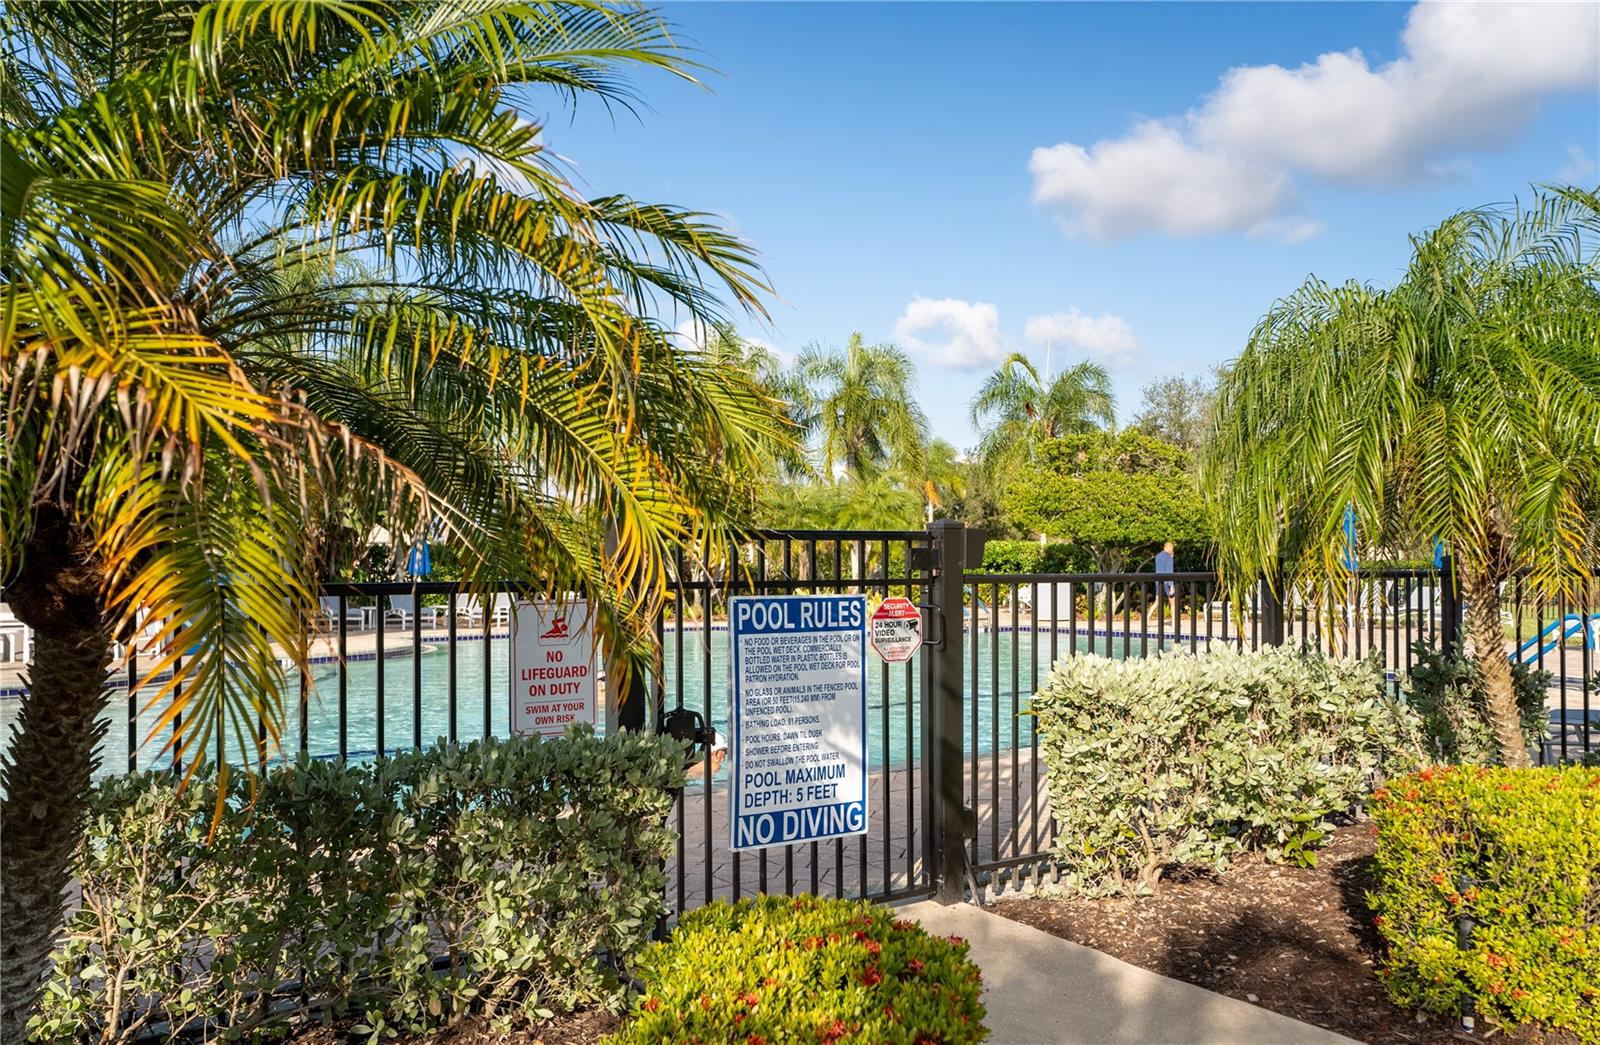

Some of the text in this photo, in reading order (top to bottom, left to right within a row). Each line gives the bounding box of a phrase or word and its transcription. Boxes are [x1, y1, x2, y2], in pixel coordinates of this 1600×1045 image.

[738, 600, 861, 631] POOL RULES
[875, 620, 902, 629] 24 HOUR
[745, 633, 859, 646] NO FOOD OR BEVERAGES IN THE POOL OR ON
[875, 629, 895, 637] VIDEO
[875, 636, 911, 644] SURVEILLANCE
[546, 650, 563, 662] NO
[745, 646, 756, 655] THE
[757, 645, 772, 655] POOL
[773, 645, 785, 654] WET
[802, 643, 842, 653] COMMERCIALLY
[745, 651, 848, 665] BOTTLED WATER IN PLASTIC BOTTLES IS
[521, 665, 588, 681] LIFEGUARD
[745, 660, 860, 674] ALLOWED ON THE POOL WET DECK FOR POOL
[745, 674, 767, 683] PATRON
[529, 682, 580, 697] ON DUTY
[745, 681, 858, 697] NO GLASS OR ANIMALS IN THE FENCED POOL
[745, 698, 761, 706] AREA
[772, 696, 779, 705] 50
[821, 692, 836, 701] FROM
[525, 701, 585, 715] SWIM AT YOUR
[745, 706, 774, 716] UNFENCED
[535, 713, 575, 725] OWN RISK
[745, 719, 770, 729] BATHING
[745, 735, 760, 743] POOL
[783, 731, 798, 741] DAWN
[808, 728, 823, 738] DUSK
[745, 746, 769, 756] SHOWER
[770, 744, 792, 754] BEFORE
[745, 761, 754, 770] DO
[754, 759, 766, 768] NOT
[767, 757, 794, 767] SWALLOW
[795, 755, 806, 764] THE
[806, 754, 820, 763] POOL
[745, 763, 845, 789] POOL MAXIMUM
[745, 783, 838, 808] DEPTH: 5 FEET
[738, 802, 863, 846] NO DIVING
